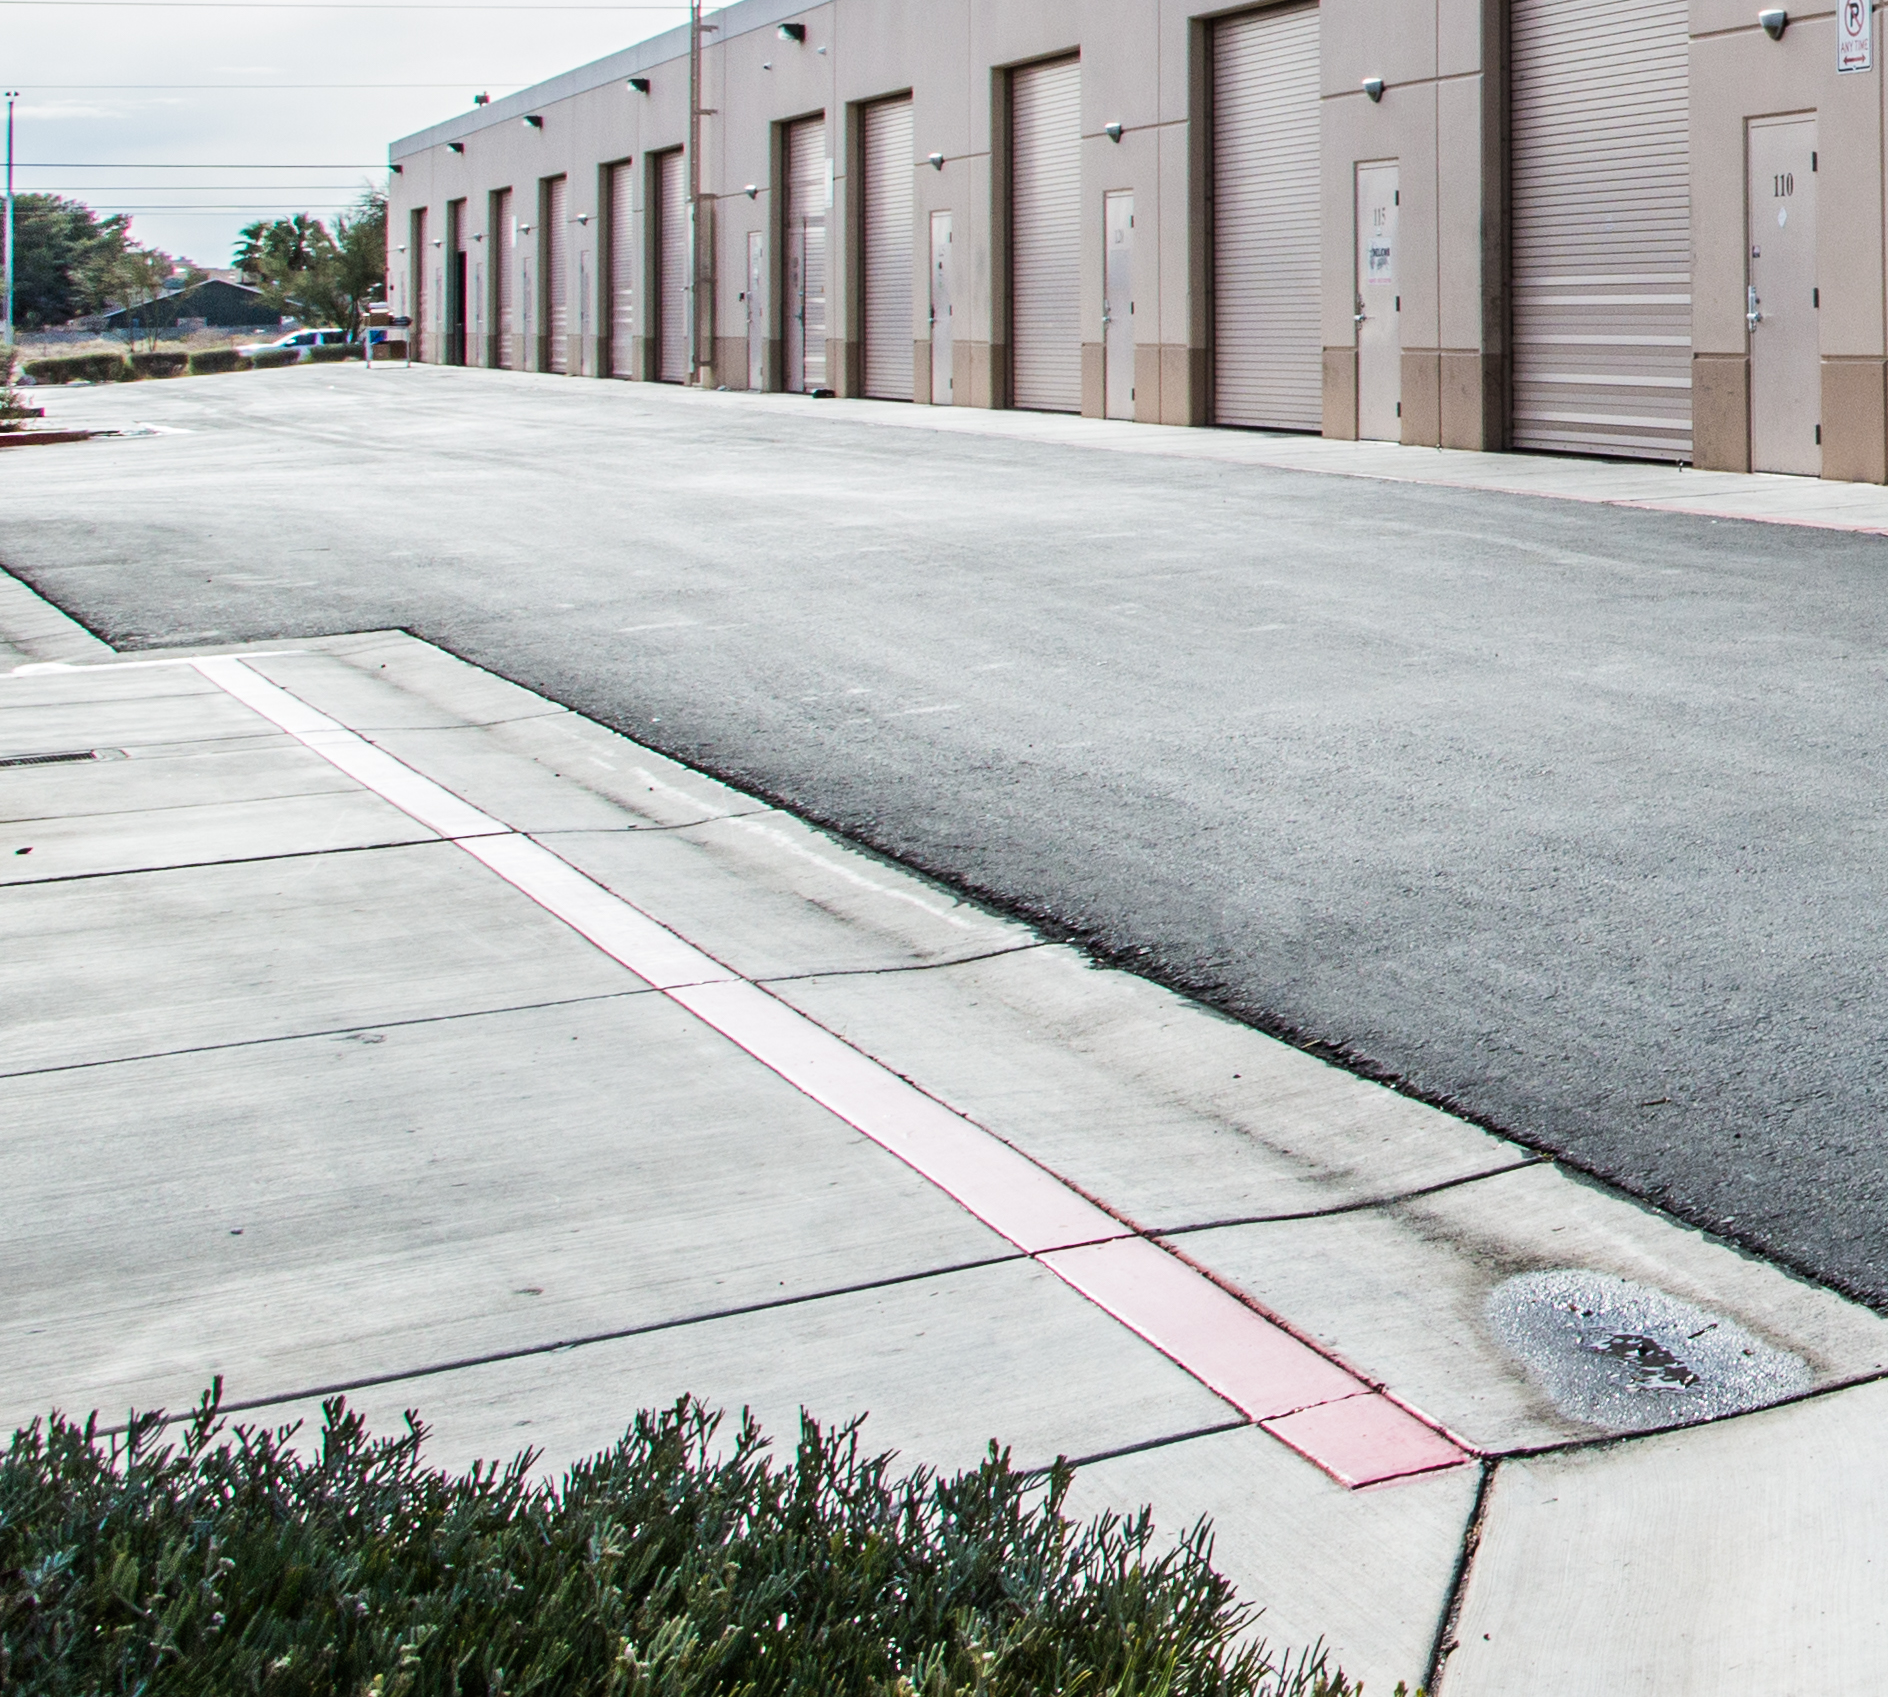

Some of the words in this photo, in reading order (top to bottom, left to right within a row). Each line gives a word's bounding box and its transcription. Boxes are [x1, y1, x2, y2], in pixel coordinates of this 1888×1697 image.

[1841, 40, 1853, 54] ANY
[1854, 38, 1869, 51] TIME
[1773, 172, 1794, 197] 110
[1373, 206, 1387, 226] 115
